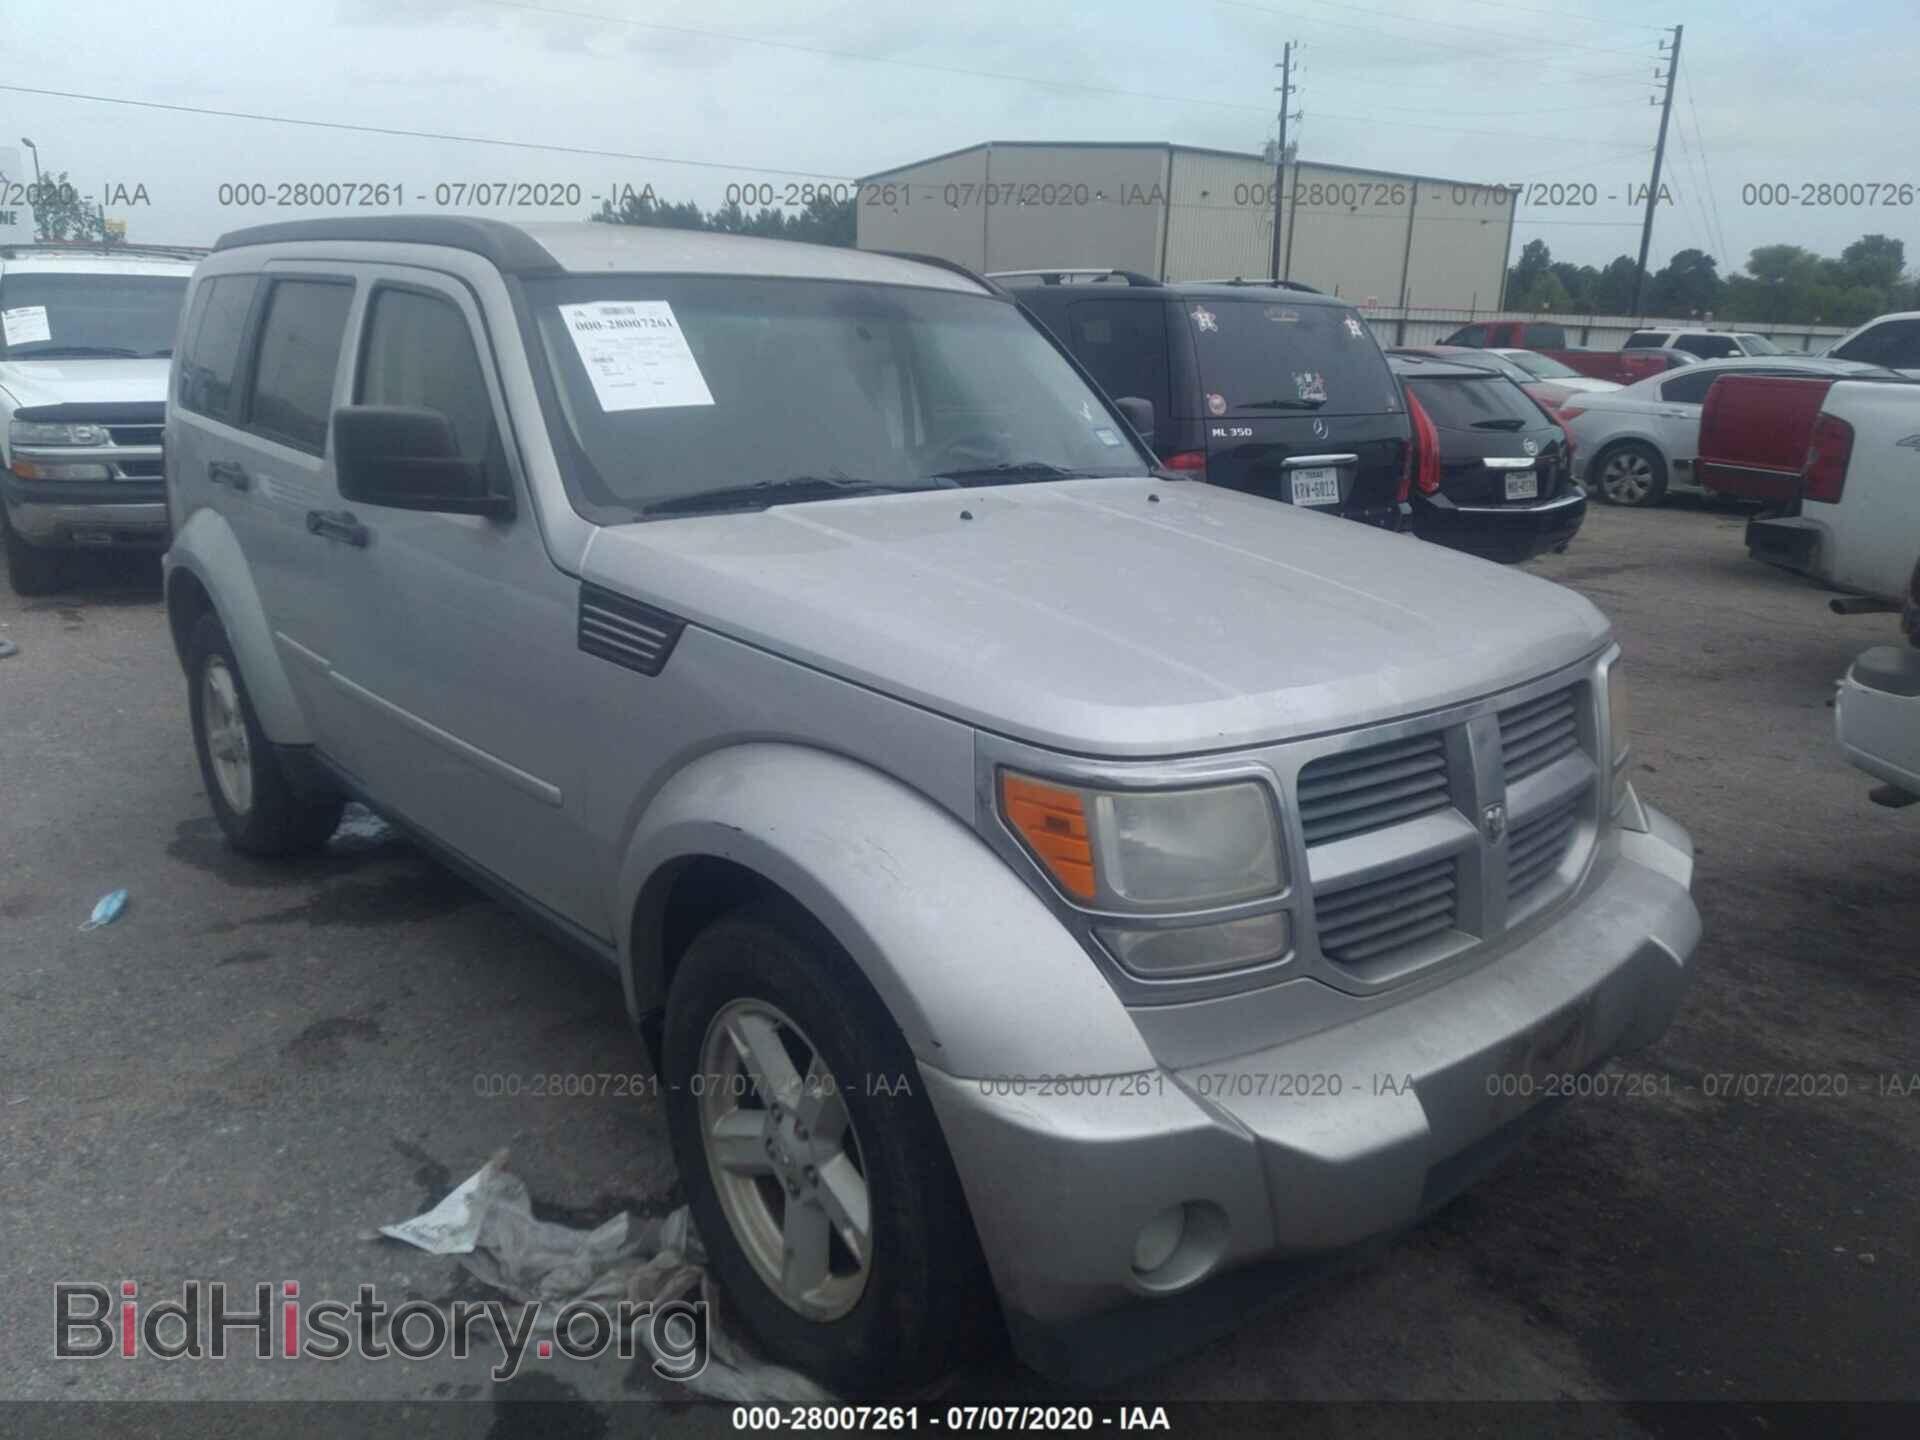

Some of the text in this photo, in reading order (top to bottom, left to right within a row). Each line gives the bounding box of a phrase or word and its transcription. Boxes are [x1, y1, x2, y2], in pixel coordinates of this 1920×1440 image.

[575, 318, 674, 331] 000-28007261
[1212, 427, 1253, 437] ML 350
